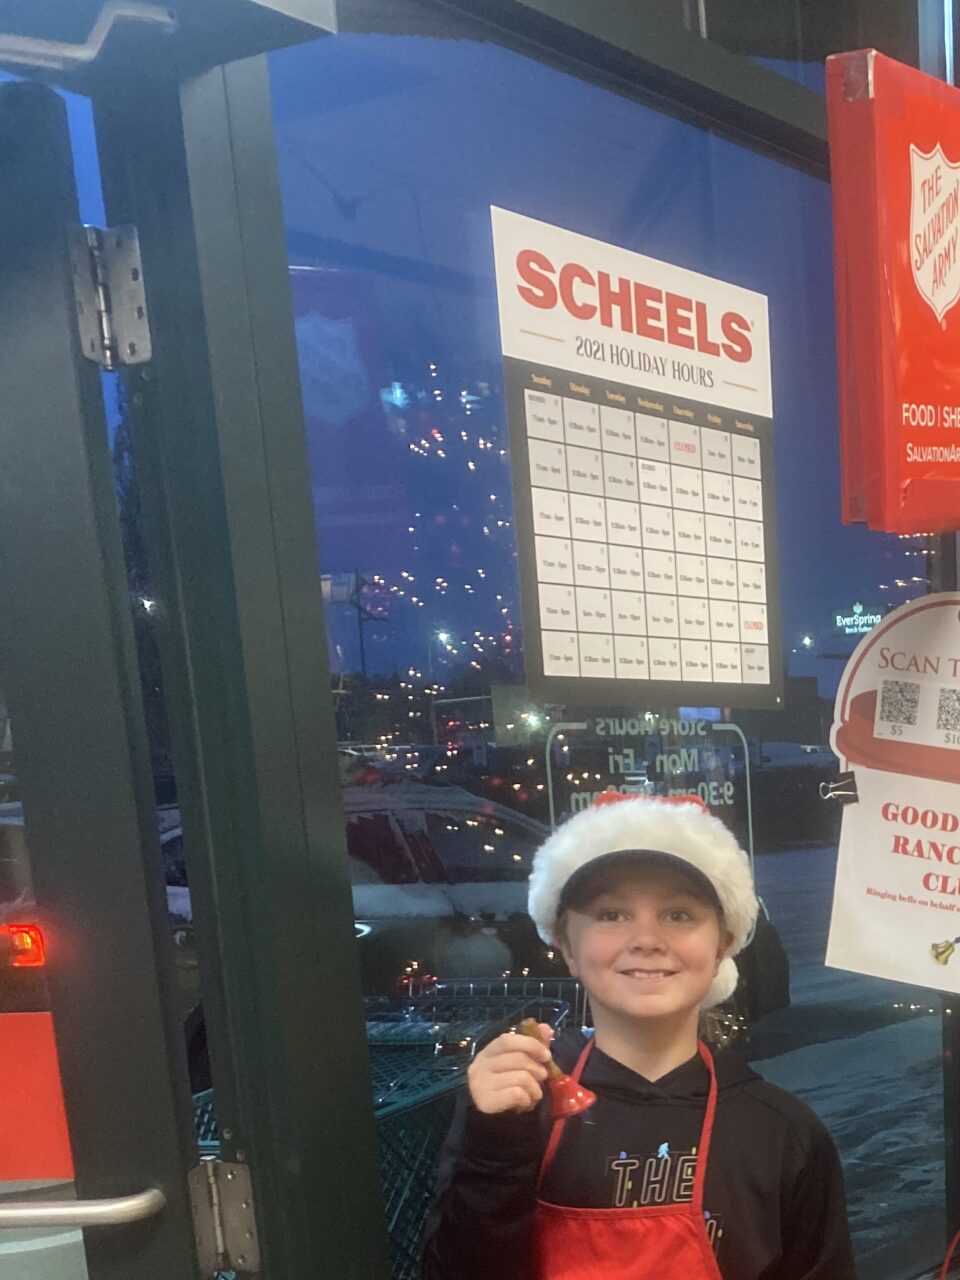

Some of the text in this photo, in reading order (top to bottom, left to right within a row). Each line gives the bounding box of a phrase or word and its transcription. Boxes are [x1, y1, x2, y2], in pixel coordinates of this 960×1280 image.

[921, 165, 942, 214] THE
[914, 178, 960, 271] SALVATION
[932, 226, 959, 297] ARMY
[516, 249, 752, 363] SCHEELS
[576, 336, 714, 388] 2021 HOLIDAY HOURS
[903, 403, 936, 427] FOOD
[890, 724, 903, 737] $5
[881, 802, 959, 833] GOOD
[866, 887, 897, 902] Ringing
[898, 894, 917, 905] bells
[930, 900, 956, 911] behalf
[611, 1156, 698, 1206] THE
